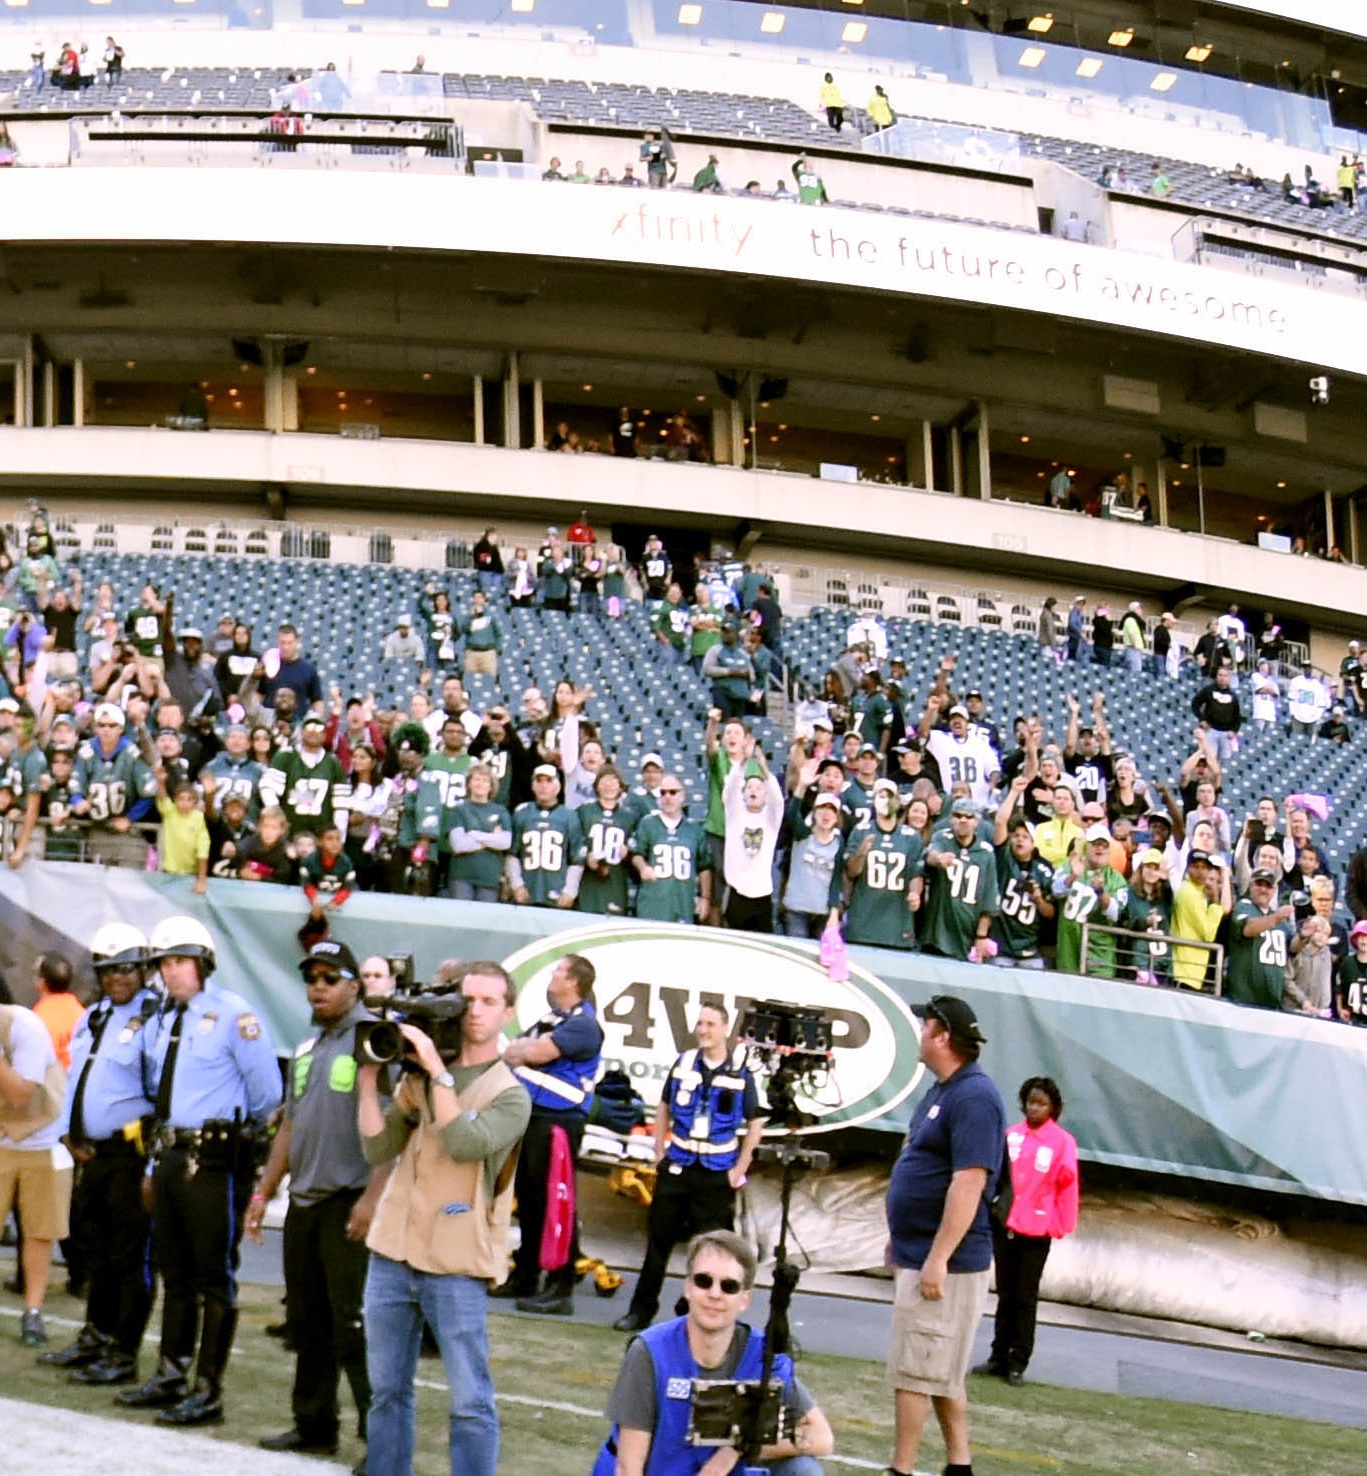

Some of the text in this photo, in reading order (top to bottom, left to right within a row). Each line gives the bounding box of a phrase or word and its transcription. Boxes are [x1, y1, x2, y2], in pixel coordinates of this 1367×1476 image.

[610, 202, 1287, 334] xfinity the future of awesome
[88, 780, 126, 821] 36
[522, 830, 564, 871] 36
[588, 823, 626, 866] 18
[652, 843, 691, 881] 36
[867, 850, 907, 891] 62
[1259, 929, 1287, 967] 29
